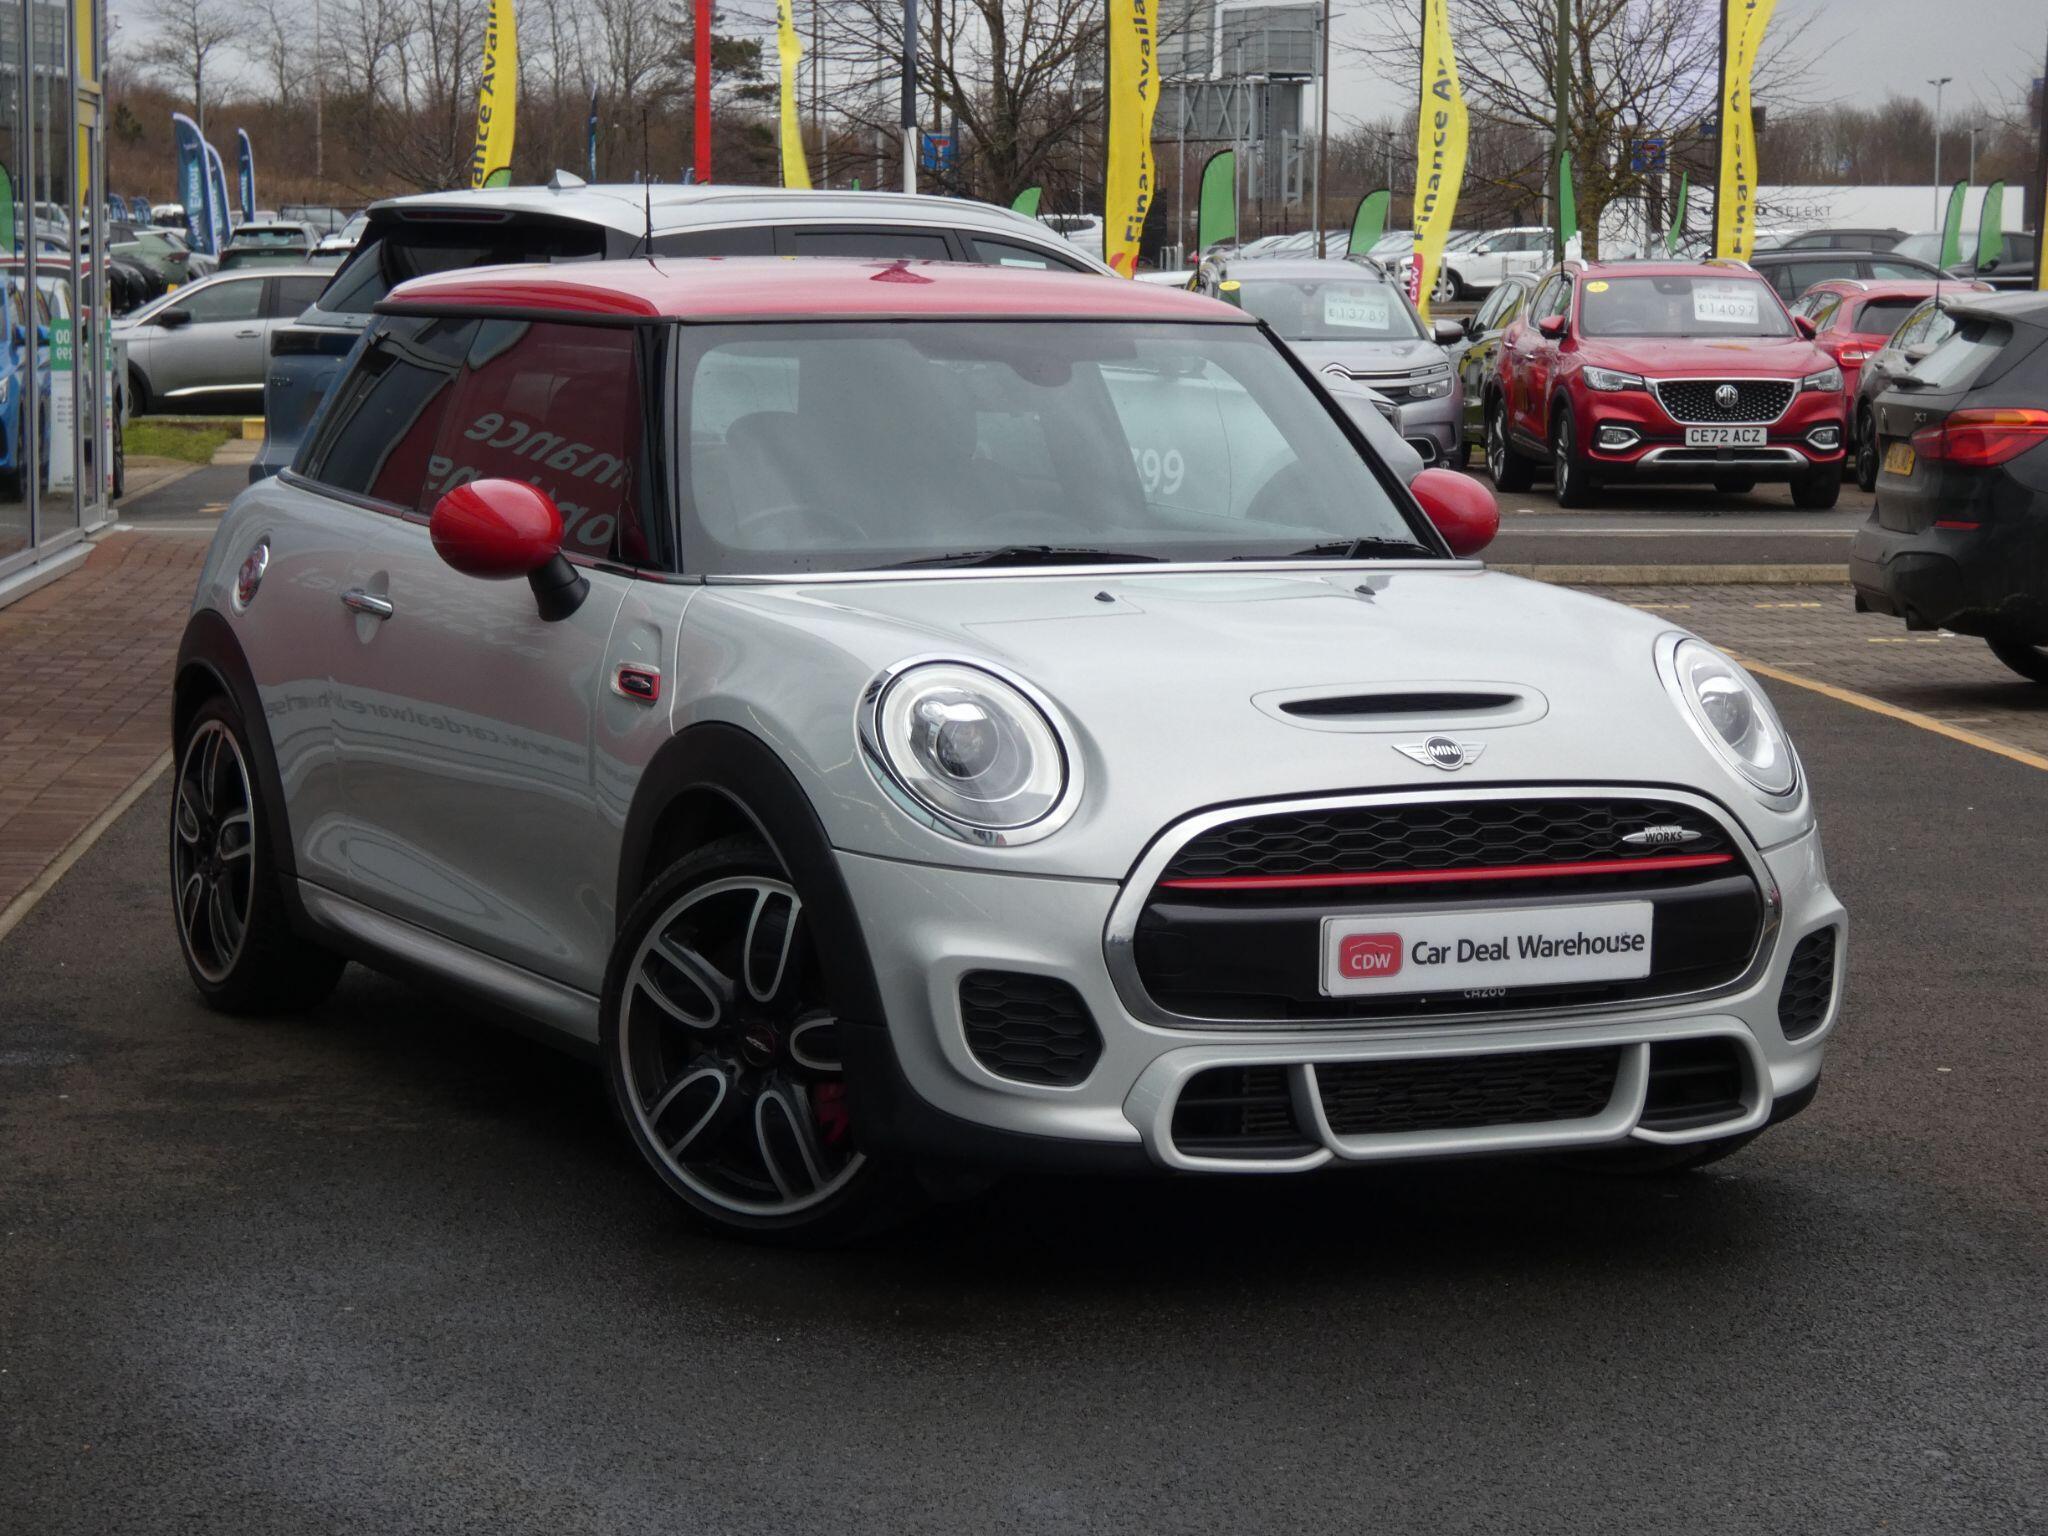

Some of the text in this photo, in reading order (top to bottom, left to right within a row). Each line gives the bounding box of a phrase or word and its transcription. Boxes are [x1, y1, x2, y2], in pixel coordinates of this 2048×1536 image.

[1124, 111, 1150, 243] Finan
[1413, 110, 1449, 241] Finance
[1732, 124, 1748, 254] Finan
[1691, 429, 1761, 443] CE72 ACZ
[1429, 744, 1461, 756] MINI
[1645, 831, 1683, 843] WORKS
[1351, 953, 1391, 971] CDW
[1411, 932, 1645, 966] Car Deal Warehouse
